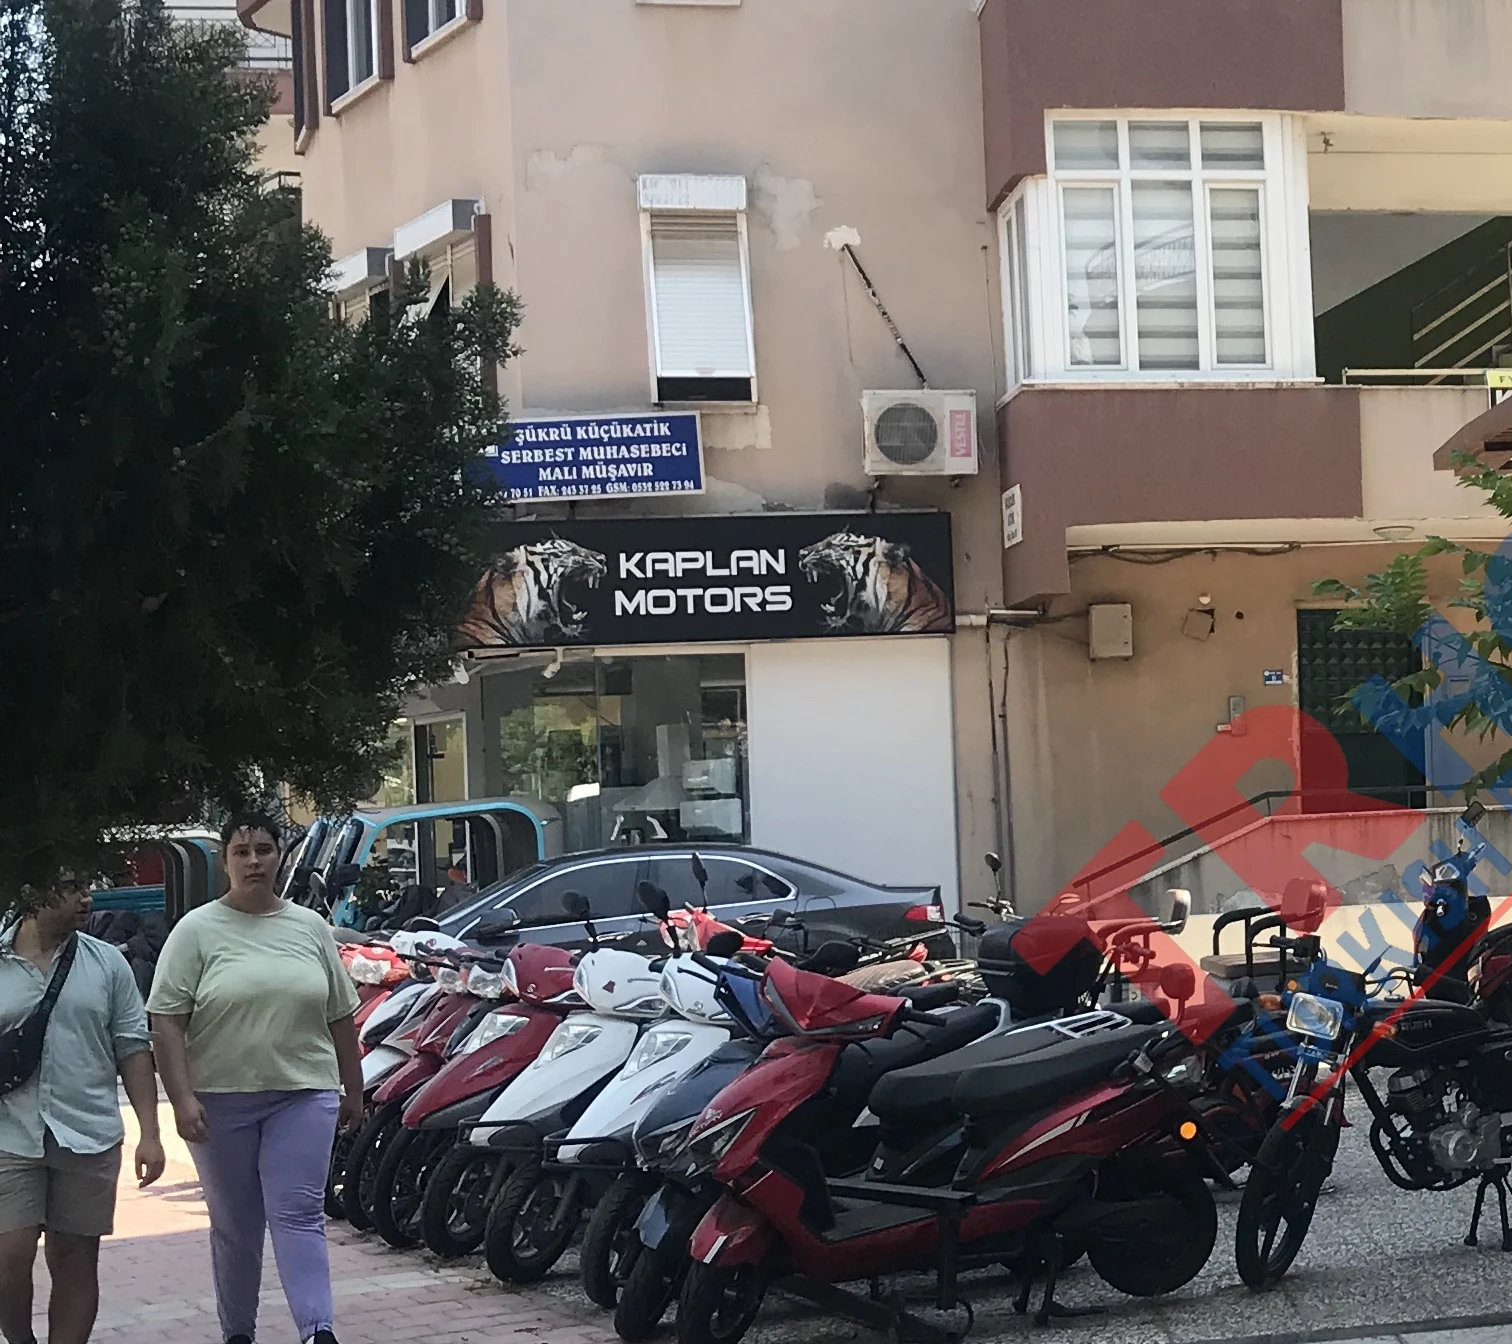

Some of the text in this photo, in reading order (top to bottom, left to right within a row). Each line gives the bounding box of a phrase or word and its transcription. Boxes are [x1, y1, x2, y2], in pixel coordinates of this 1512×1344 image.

[515, 420, 672, 446] ŞÜKRÜ KÜÇÜKATİK
[500, 447, 575, 464] SERBEST
[619, 548, 786, 578] KAPLAN
[614, 585, 793, 616] MOTORS
